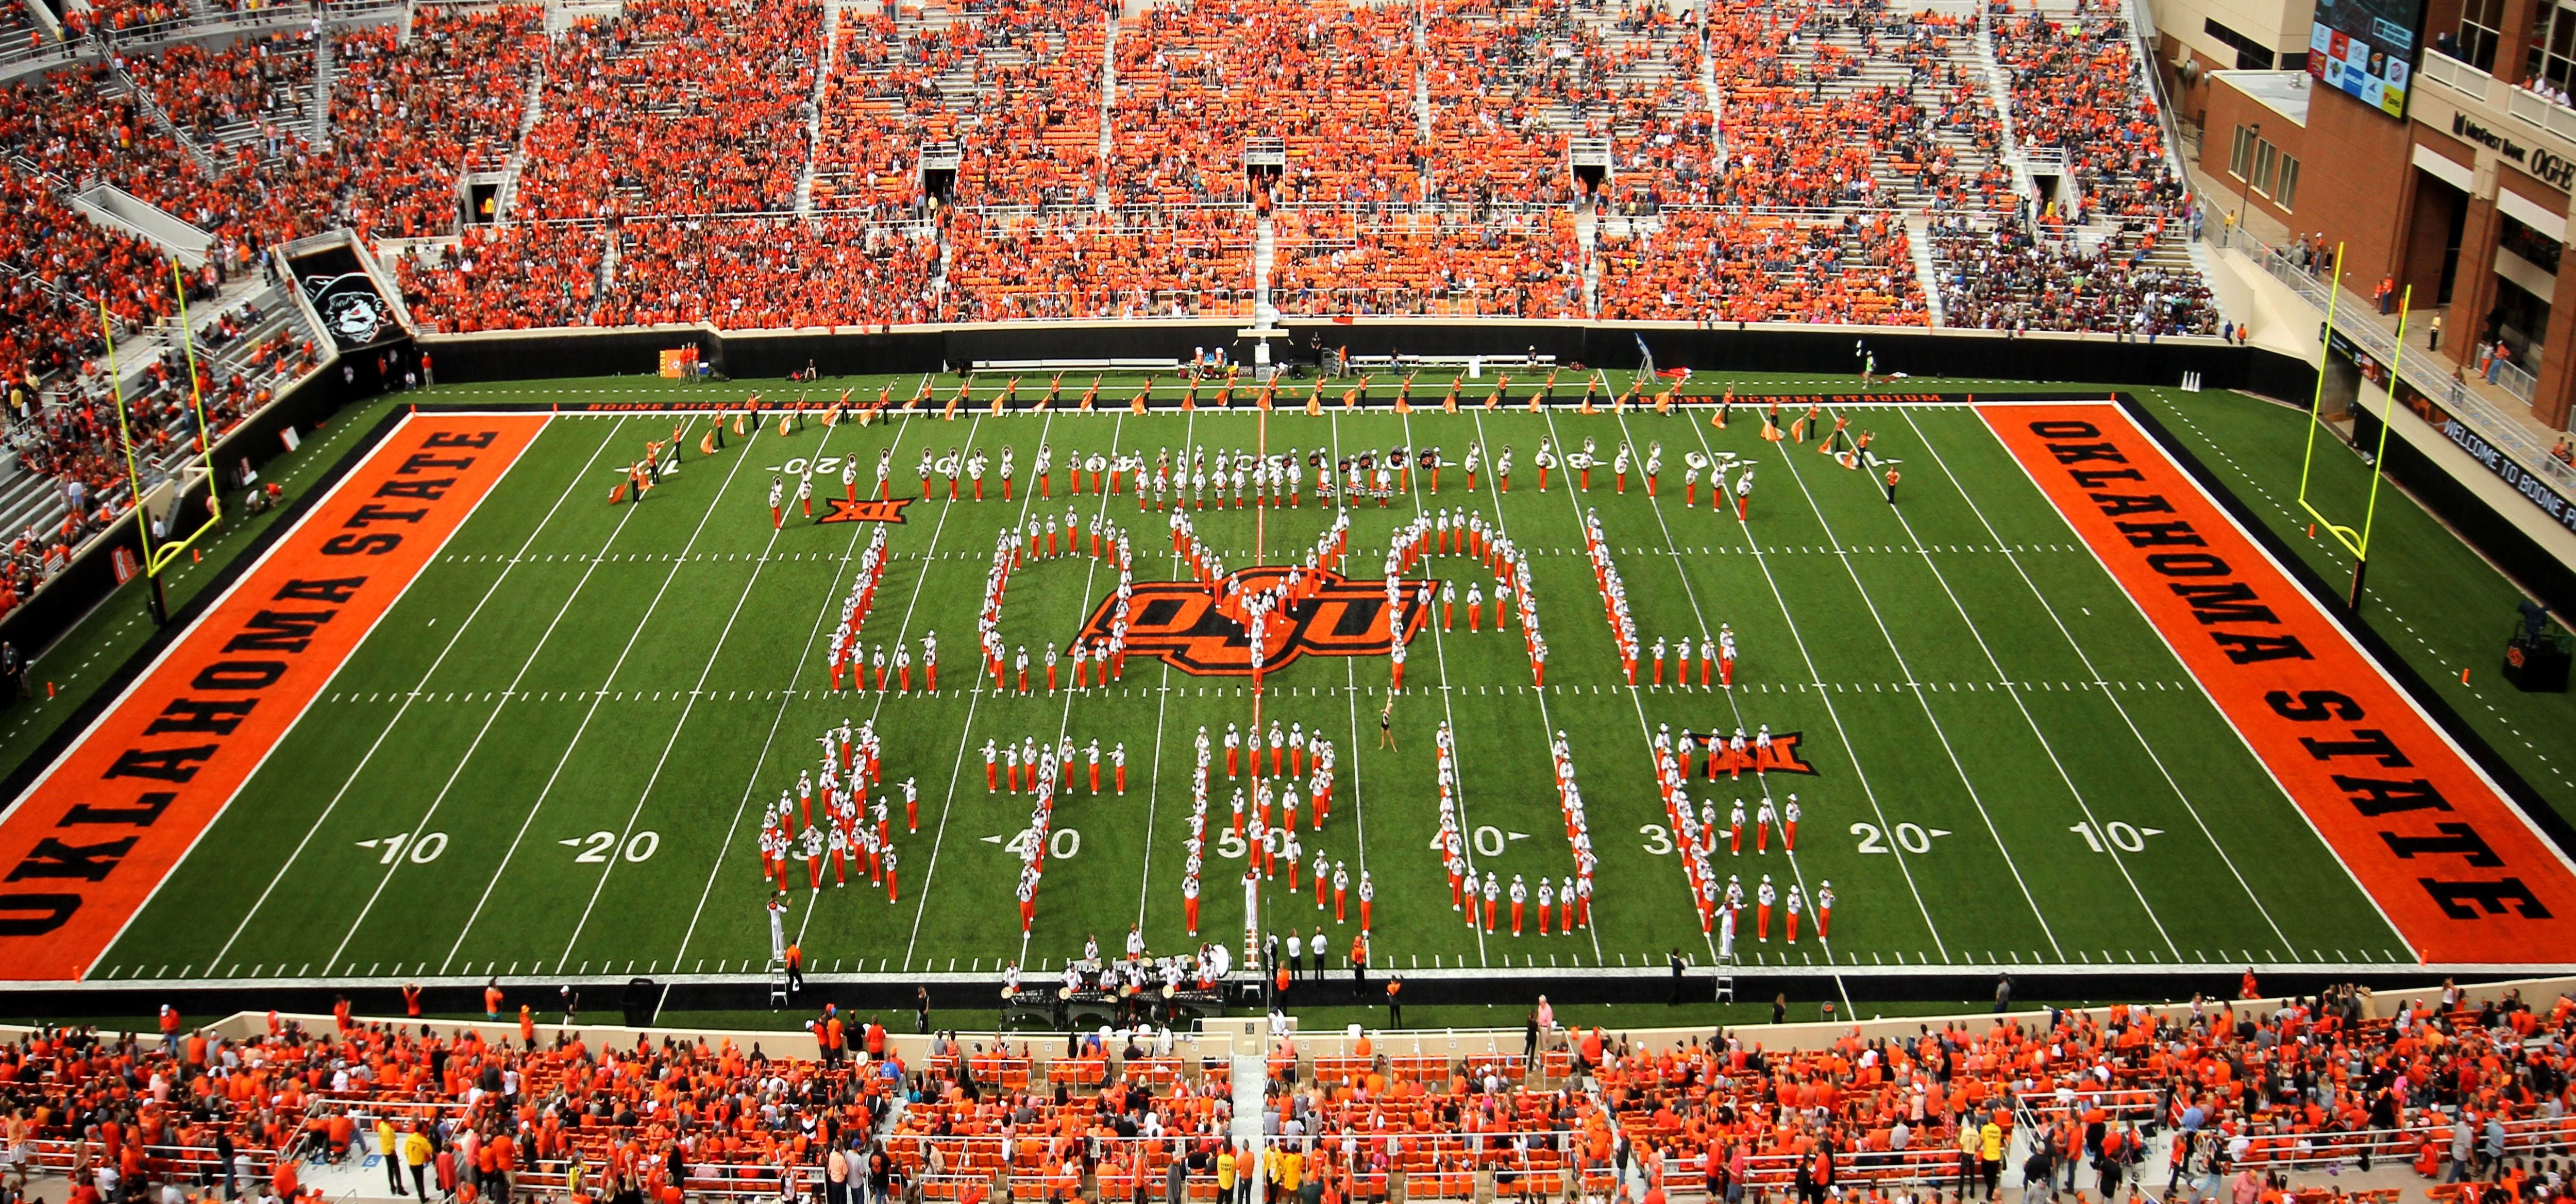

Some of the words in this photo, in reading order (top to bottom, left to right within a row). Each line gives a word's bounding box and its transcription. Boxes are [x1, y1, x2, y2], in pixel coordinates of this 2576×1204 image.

[2443, 418, 2501, 471] WELCOME
[2501, 457, 2520, 485] TO
[2518, 473, 2565, 518] BOONE
[817, 498, 915, 524] XII
[1064, 565, 1442, 676] OSU
[0, 576, 368, 936] OKLAHOMA
[322, 431, 498, 555] STATE
[2029, 420, 2315, 665] OKLAHOMA
[2264, 690, 2554, 919] STATE
[380, 833, 448, 864] 10
[578, 831, 658, 863] 20
[1005, 828, 1081, 859] 40
[1217, 826, 1288, 858] 50
[1849, 822, 1931, 854] 20
[2069, 821, 2145, 852] 10
[1675, 1062, 1686, 1073] 30
